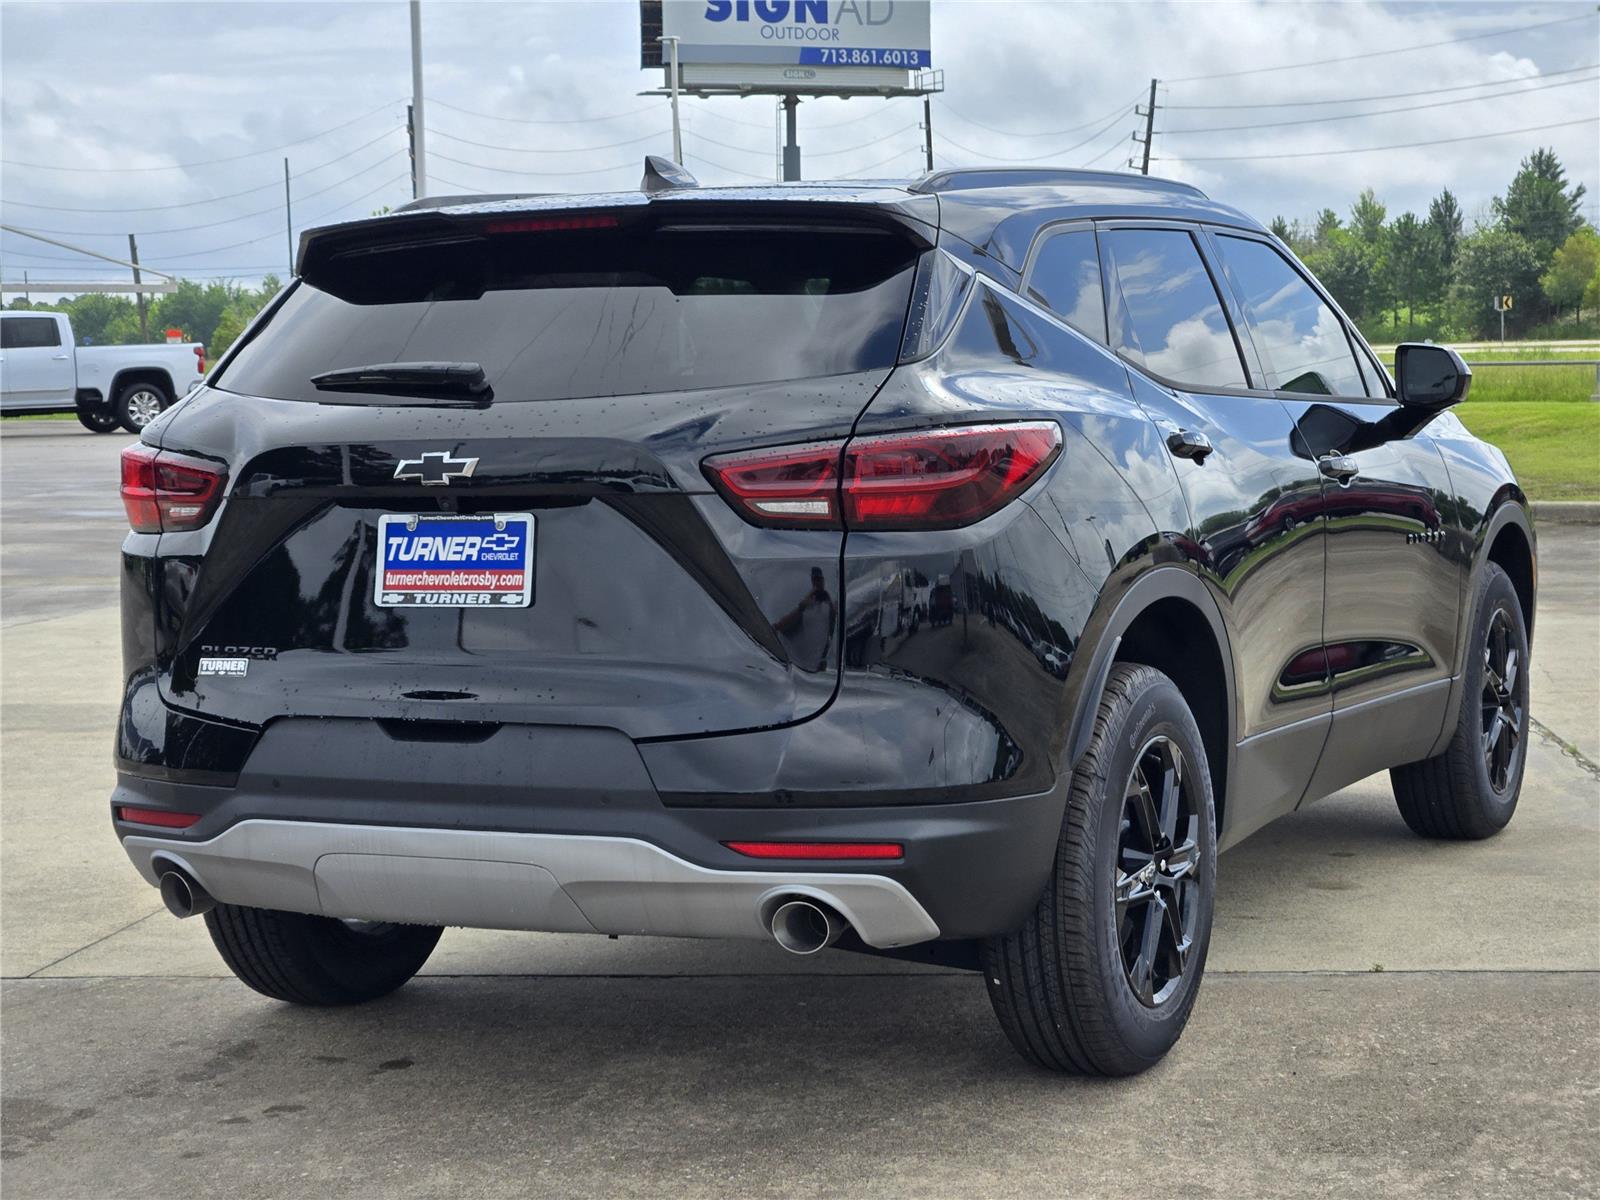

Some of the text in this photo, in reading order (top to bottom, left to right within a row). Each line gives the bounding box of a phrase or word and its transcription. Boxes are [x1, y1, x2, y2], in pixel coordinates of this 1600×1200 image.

[704, 0, 894, 26] SIGN AD
[760, 25, 840, 41] OUTDOOR
[820, 49, 919, 65] 713.861.6013
[388, 536, 482, 562] TURNER
[481, 552, 520, 561] CHEVROLET
[385, 571, 523, 589] turnerchevroletcrosby.com
[413, 593, 492, 604] TURNER
[202, 660, 246, 671] TURNER
